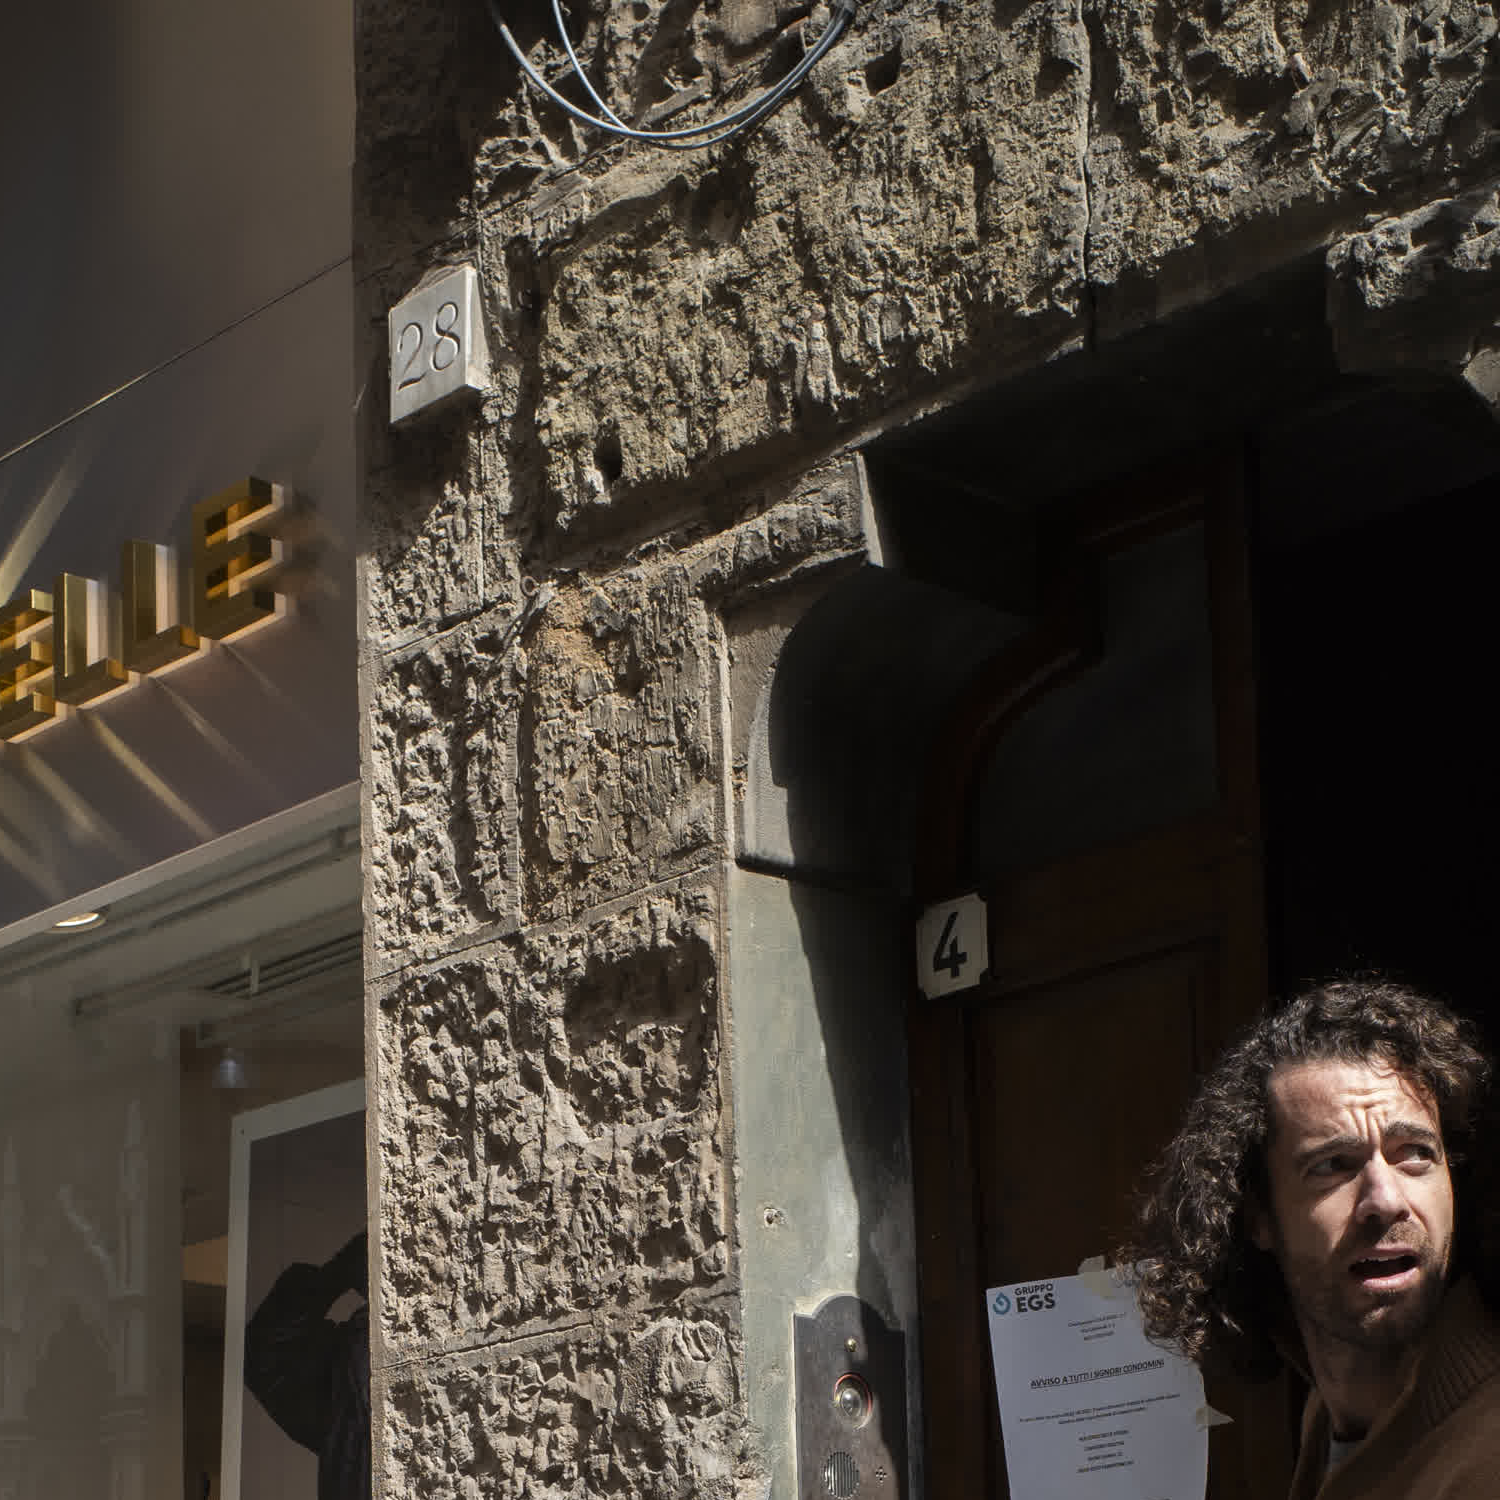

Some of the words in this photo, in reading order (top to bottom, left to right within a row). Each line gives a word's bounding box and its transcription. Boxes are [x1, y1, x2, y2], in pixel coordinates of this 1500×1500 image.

[396, 302, 461, 392] 28
[933, 911, 968, 979] 4
[1014, 1283, 1054, 1296] GRUPPO
[1016, 1293, 1056, 1313] EGS
[1030, 1377, 1061, 1387] AVVISO
[1123, 1359, 1165, 1373] CONDOMINI
